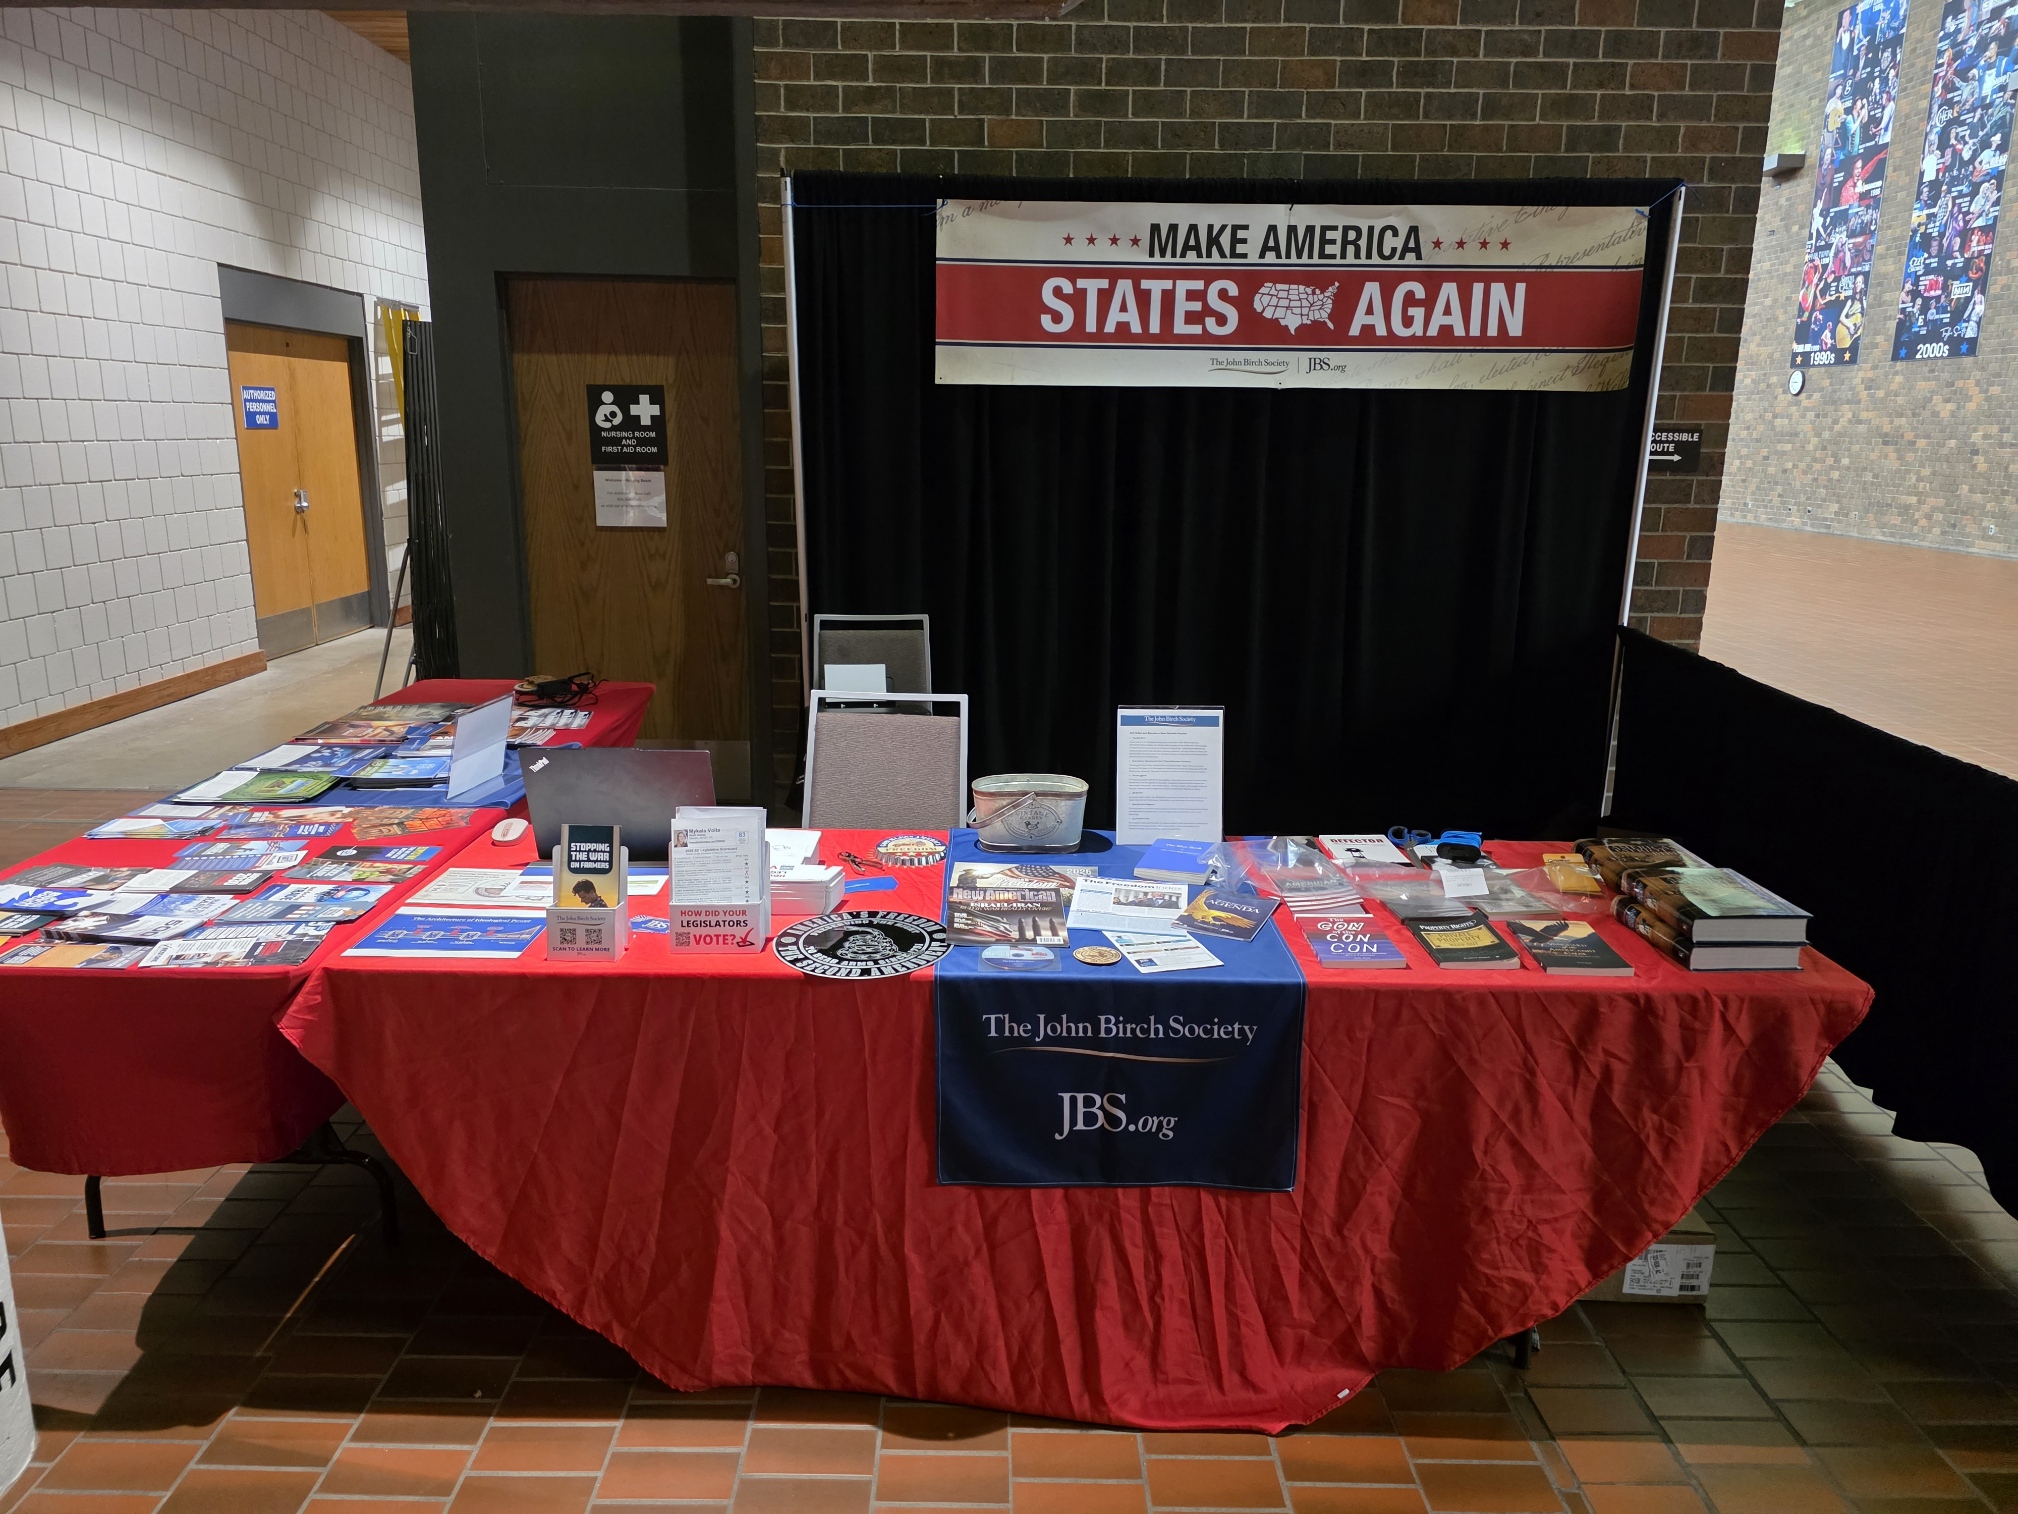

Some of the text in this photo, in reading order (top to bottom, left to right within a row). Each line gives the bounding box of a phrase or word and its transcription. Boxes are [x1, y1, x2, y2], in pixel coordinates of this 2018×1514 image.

[1148, 224, 1249, 260] MAKE
[1258, 224, 1423, 261] AMERICA
[1040, 277, 1526, 338] STATES AGAIN
[1916, 342, 1949, 359] 2000s
[1210, 358, 1290, 368] The John Birch Society
[1810, 351, 1835, 365] 1990s
[1306, 357, 1347, 374] JBS.org
[243, 389, 275, 400] AUTHORIZED
[246, 402, 276, 412] PERSONNEL
[256, 414, 270, 424] ONLY
[1651, 432, 1699, 441] CCESSIBLE
[570, 843, 610, 851] STOPPING
[571, 852, 609, 861] THE WAR
[1105, 880, 1155, 889] Freedom
[953, 888, 1056, 902] New American
[1206, 899, 1259, 913] AGENDA
[787, 911, 869, 936] AMERICA'S
[876, 911, 943, 932] FREEDOM
[1317, 921, 1364, 931] CON
[693, 934, 736, 946] VOTE?
[1326, 933, 1371, 942] CON
[1437, 935, 1481, 943] PROPERTY
[1330, 943, 1377, 953] CON
[778, 941, 948, 977] THE SECOND AMENDMENT
[982, 1014, 1258, 1046] The John Birch Society
[1054, 1092, 1178, 1140] JBS.org
